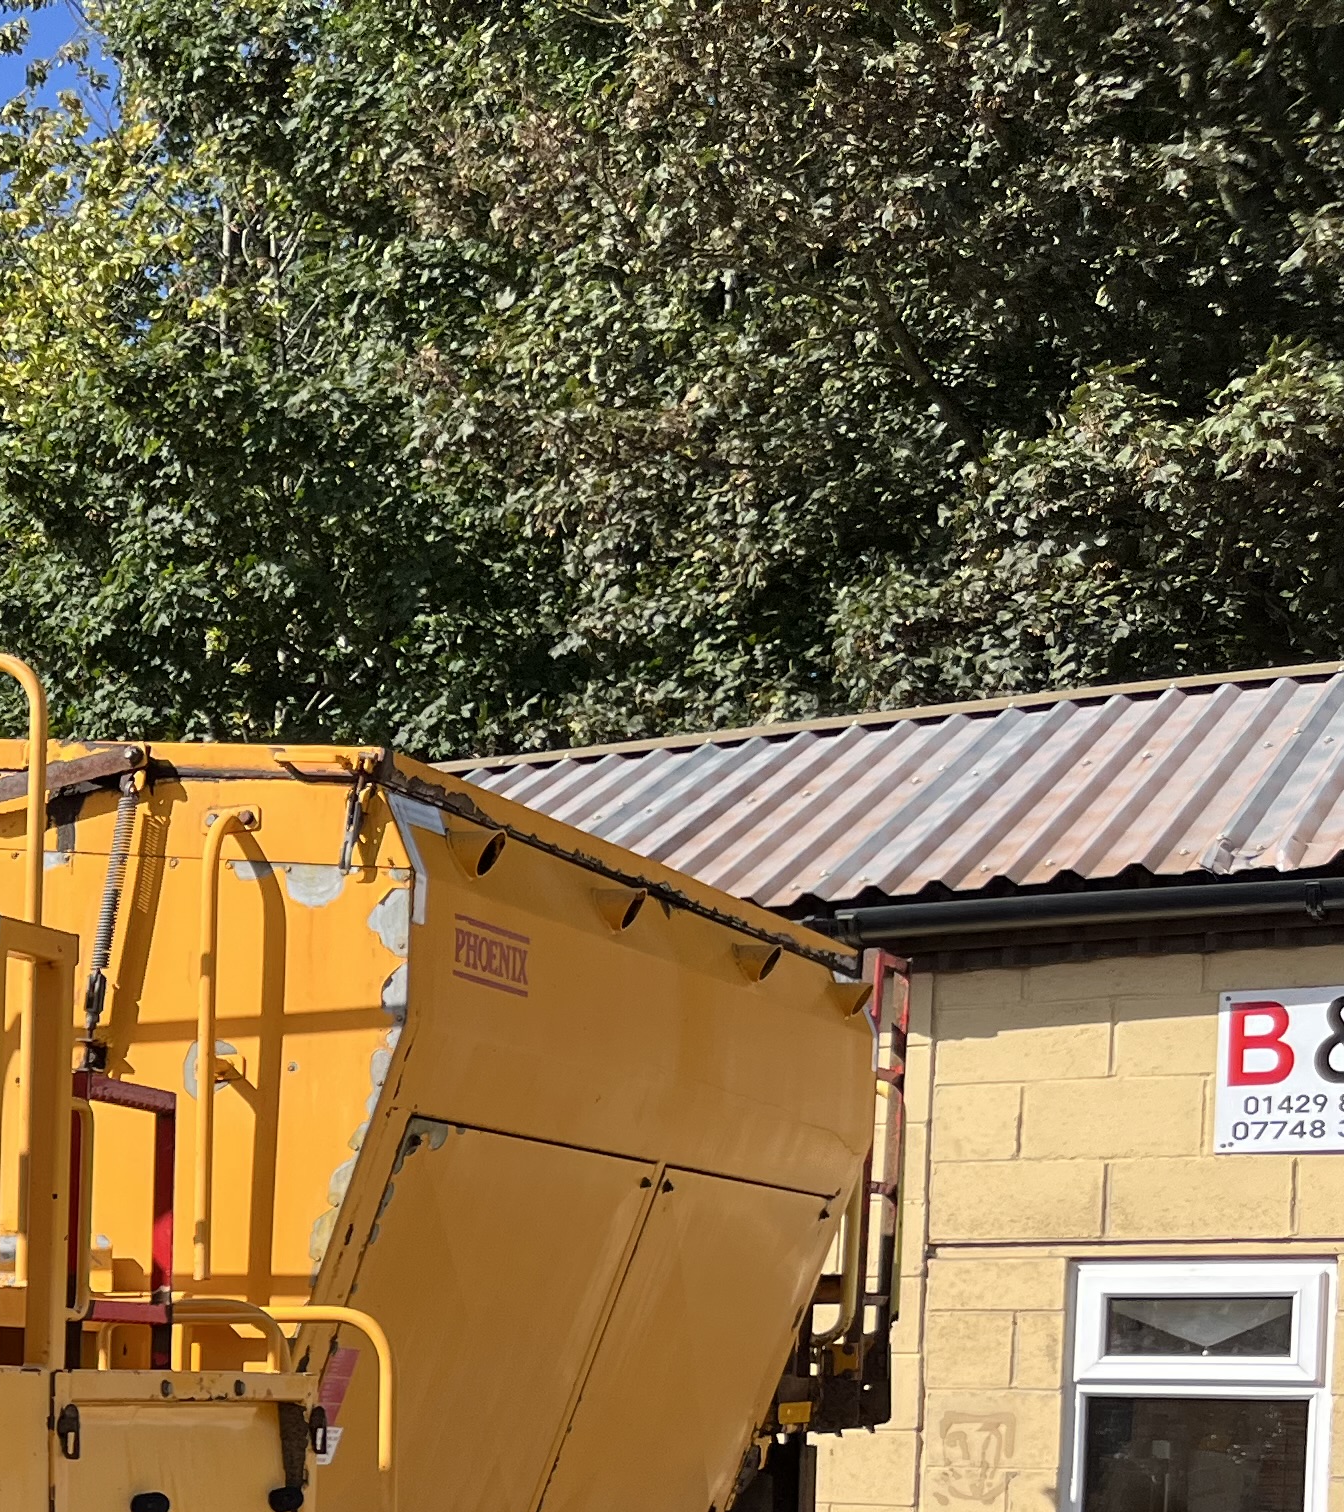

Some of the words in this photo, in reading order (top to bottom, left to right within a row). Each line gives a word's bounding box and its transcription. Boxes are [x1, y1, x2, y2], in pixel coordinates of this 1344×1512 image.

[455, 927, 528, 985] PHOENIX
[1227, 1001, 1295, 1087] B
[1243, 1094, 1328, 1115] 01429
[1232, 1119, 1326, 1141] 07748
